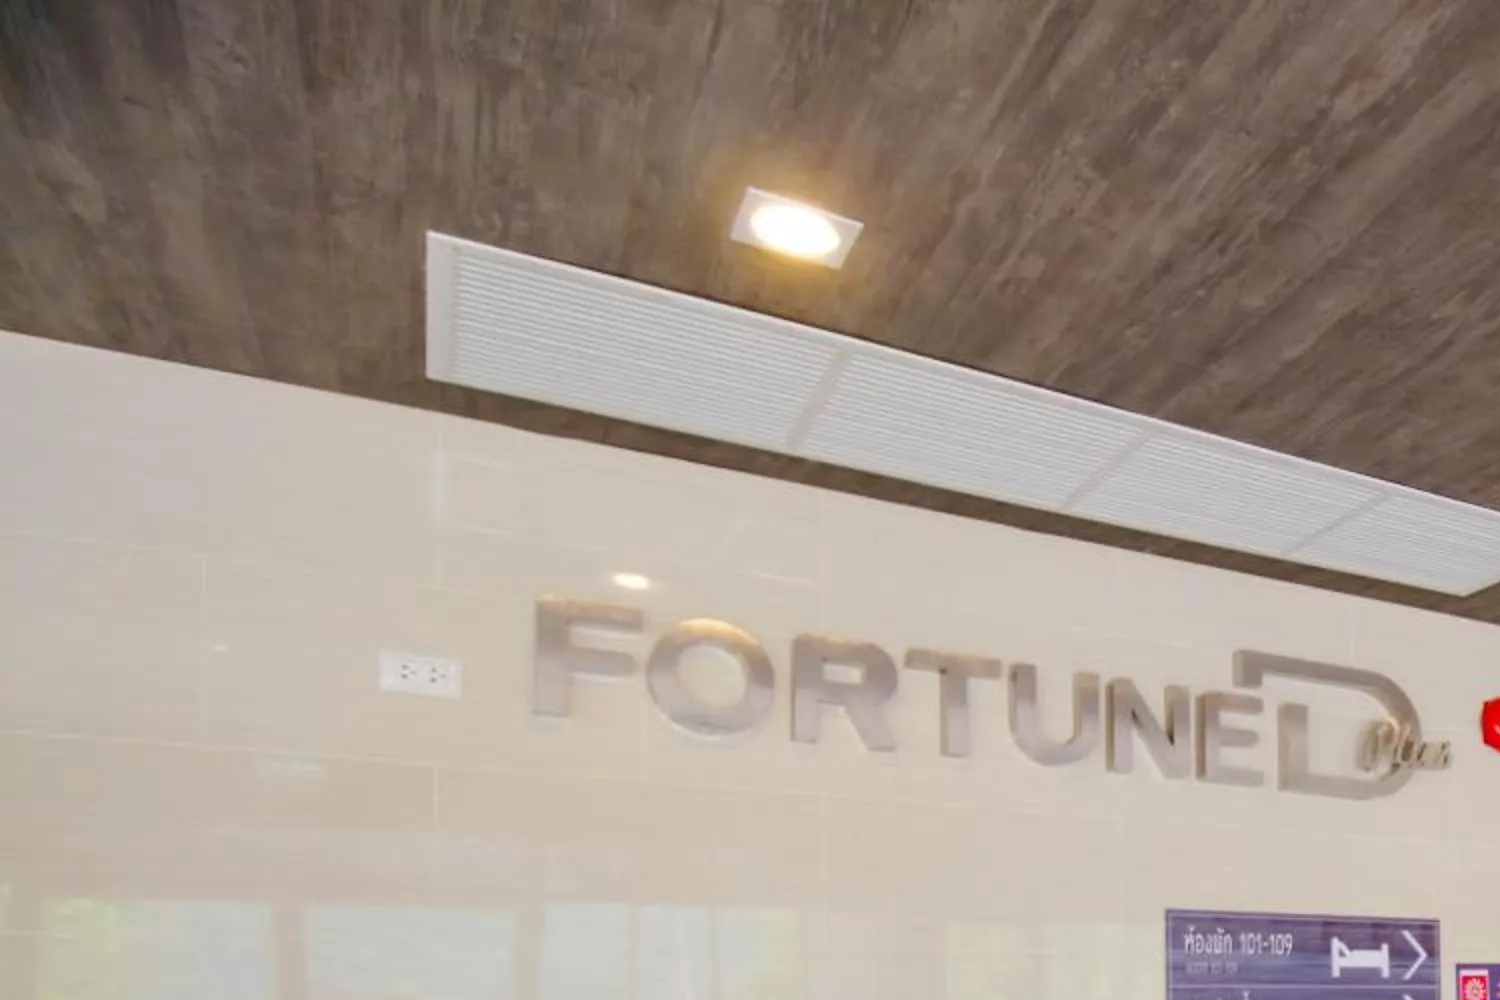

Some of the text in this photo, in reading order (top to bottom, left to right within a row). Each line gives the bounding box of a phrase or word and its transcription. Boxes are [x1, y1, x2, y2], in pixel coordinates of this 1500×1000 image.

[1184, 924, 1293, 956] ห้องพัก 101-109
